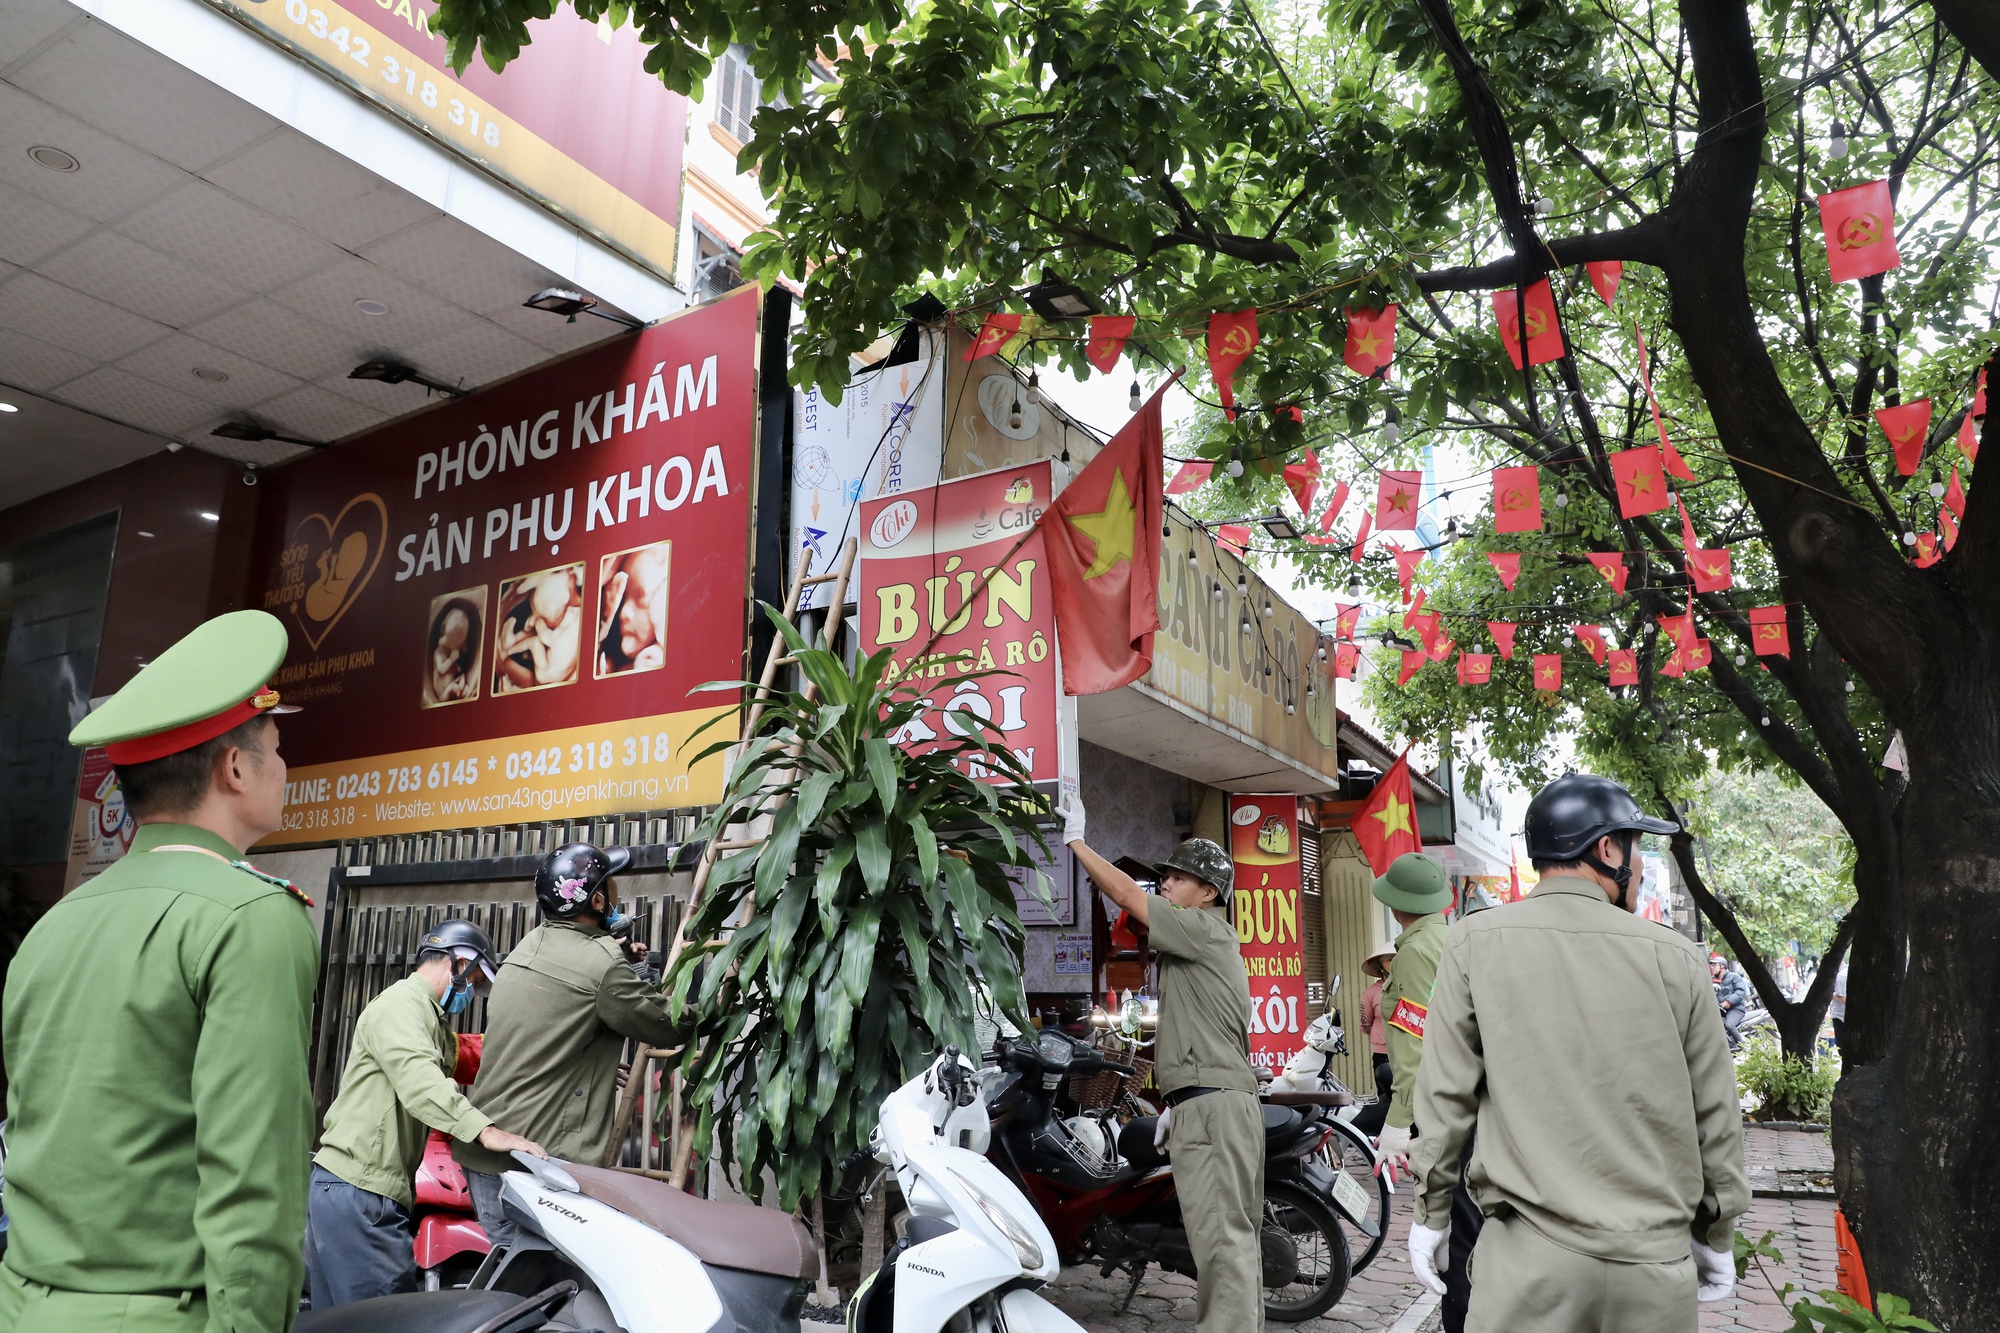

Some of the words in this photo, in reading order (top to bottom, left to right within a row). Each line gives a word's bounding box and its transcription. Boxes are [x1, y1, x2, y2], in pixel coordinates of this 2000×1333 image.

[285, 0, 371, 68] 0342
[381, 56, 438, 108] 318
[447, 98, 500, 148] 318
[414, 410, 559, 499] PHÒNG
[572, 355, 719, 450] KHÁM
[395, 513, 472, 582] SẢN
[483, 488, 575, 560] PHỤ
[585, 445, 729, 533] KHOA
[875, 504, 911, 543] Chi
[998, 503, 1043, 530] Cafe
[875, 556, 1037, 645] BÚN
[281, 662, 307, 684] KHÁM
[308, 656, 325, 678] SẢN
[327, 654, 347, 676] PHỤ
[349, 649, 375, 671] KHOA
[876, 652, 947, 685] ANH
[955, 638, 997, 673] CÁ
[1005, 630, 1049, 667] RÔ
[886, 680, 1028, 745] XÔI
[1151, 650, 1177, 695] XÔI
[1228, 693, 1253, 735] RÁN
[284, 778, 332, 806] TLINE:
[336, 771, 381, 800] 0243
[387, 765, 422, 794] 783
[427, 758, 478, 789] 6145
[506, 747, 562, 780] 0342
[569, 740, 613, 773] 318
[622, 732, 670, 767] 318
[107, 809, 119, 823] 5K
[306, 810, 329, 829] 318
[332, 806, 355, 825] 318
[375, 798, 435, 822] Website:
[440, 774, 689, 815] www.san43nguyenkhang.vn
[1234, 872, 1298, 944] BÚN
[1244, 957, 1267, 977] ANH
[1268, 951, 1284, 977] CÁ
[1286, 951, 1302, 977] RÔ
[1247, 984, 1299, 1034] XÔI
[1247, 1045, 1274, 1067] UỐC
[1277, 1047, 1299, 1067] RÁ
[538, 1195, 588, 1224] VISION
[907, 1262, 946, 1278] HONDA
